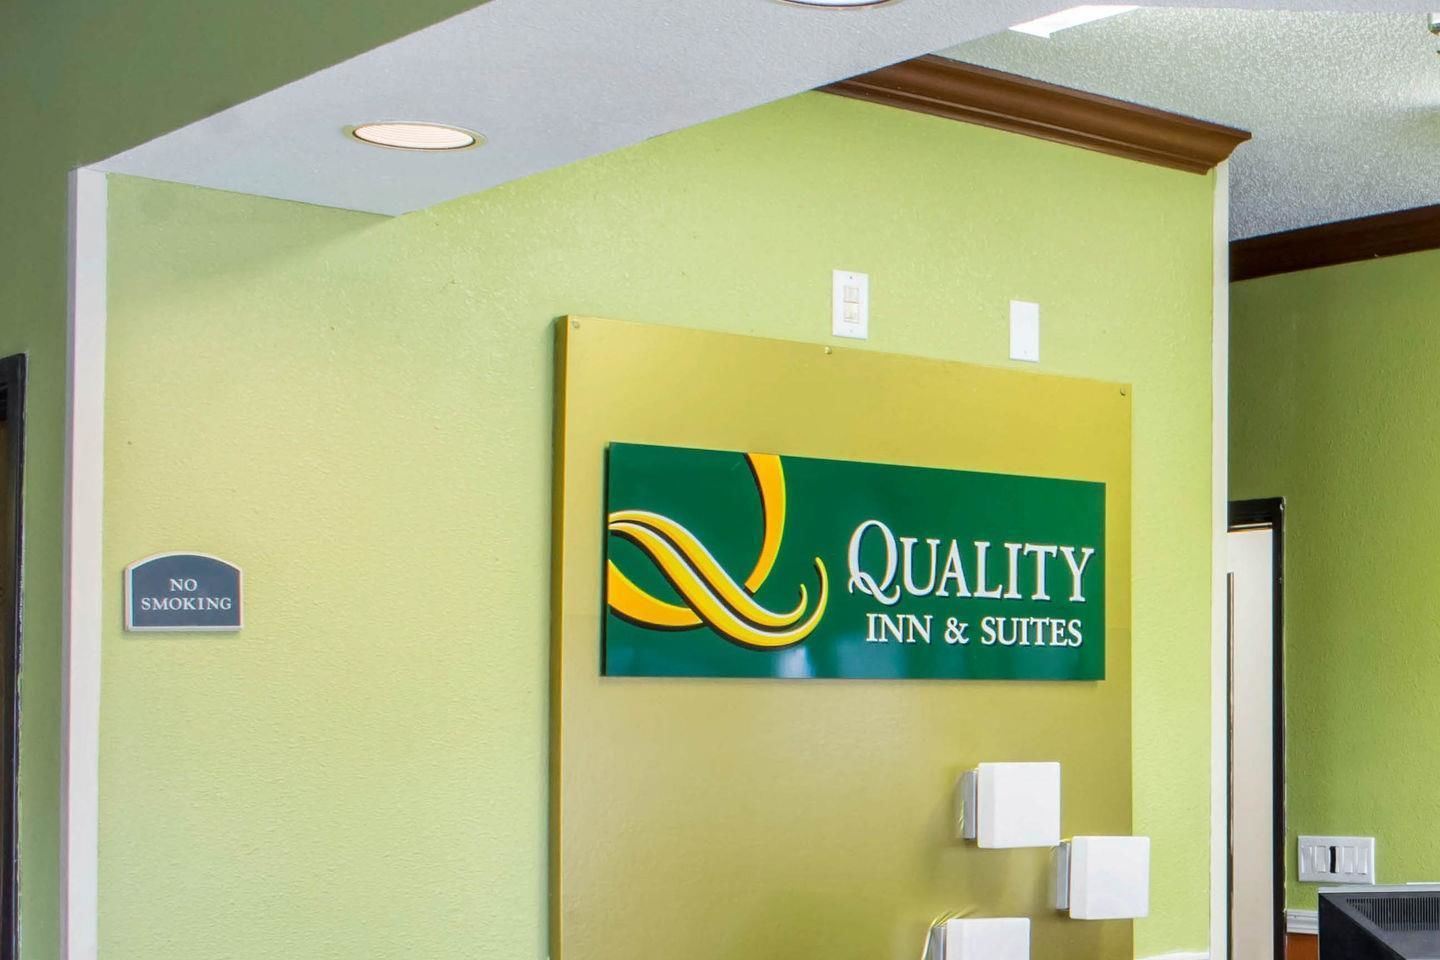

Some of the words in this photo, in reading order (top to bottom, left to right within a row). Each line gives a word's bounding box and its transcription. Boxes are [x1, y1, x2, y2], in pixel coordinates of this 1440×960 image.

[848, 518, 1095, 606] QUALITY
[169, 578, 198, 592] NO
[141, 597, 232, 610] SMOKING
[866, 612, 933, 646] INN
[944, 617, 970, 646] &
[980, 615, 1083, 648] SUITES
